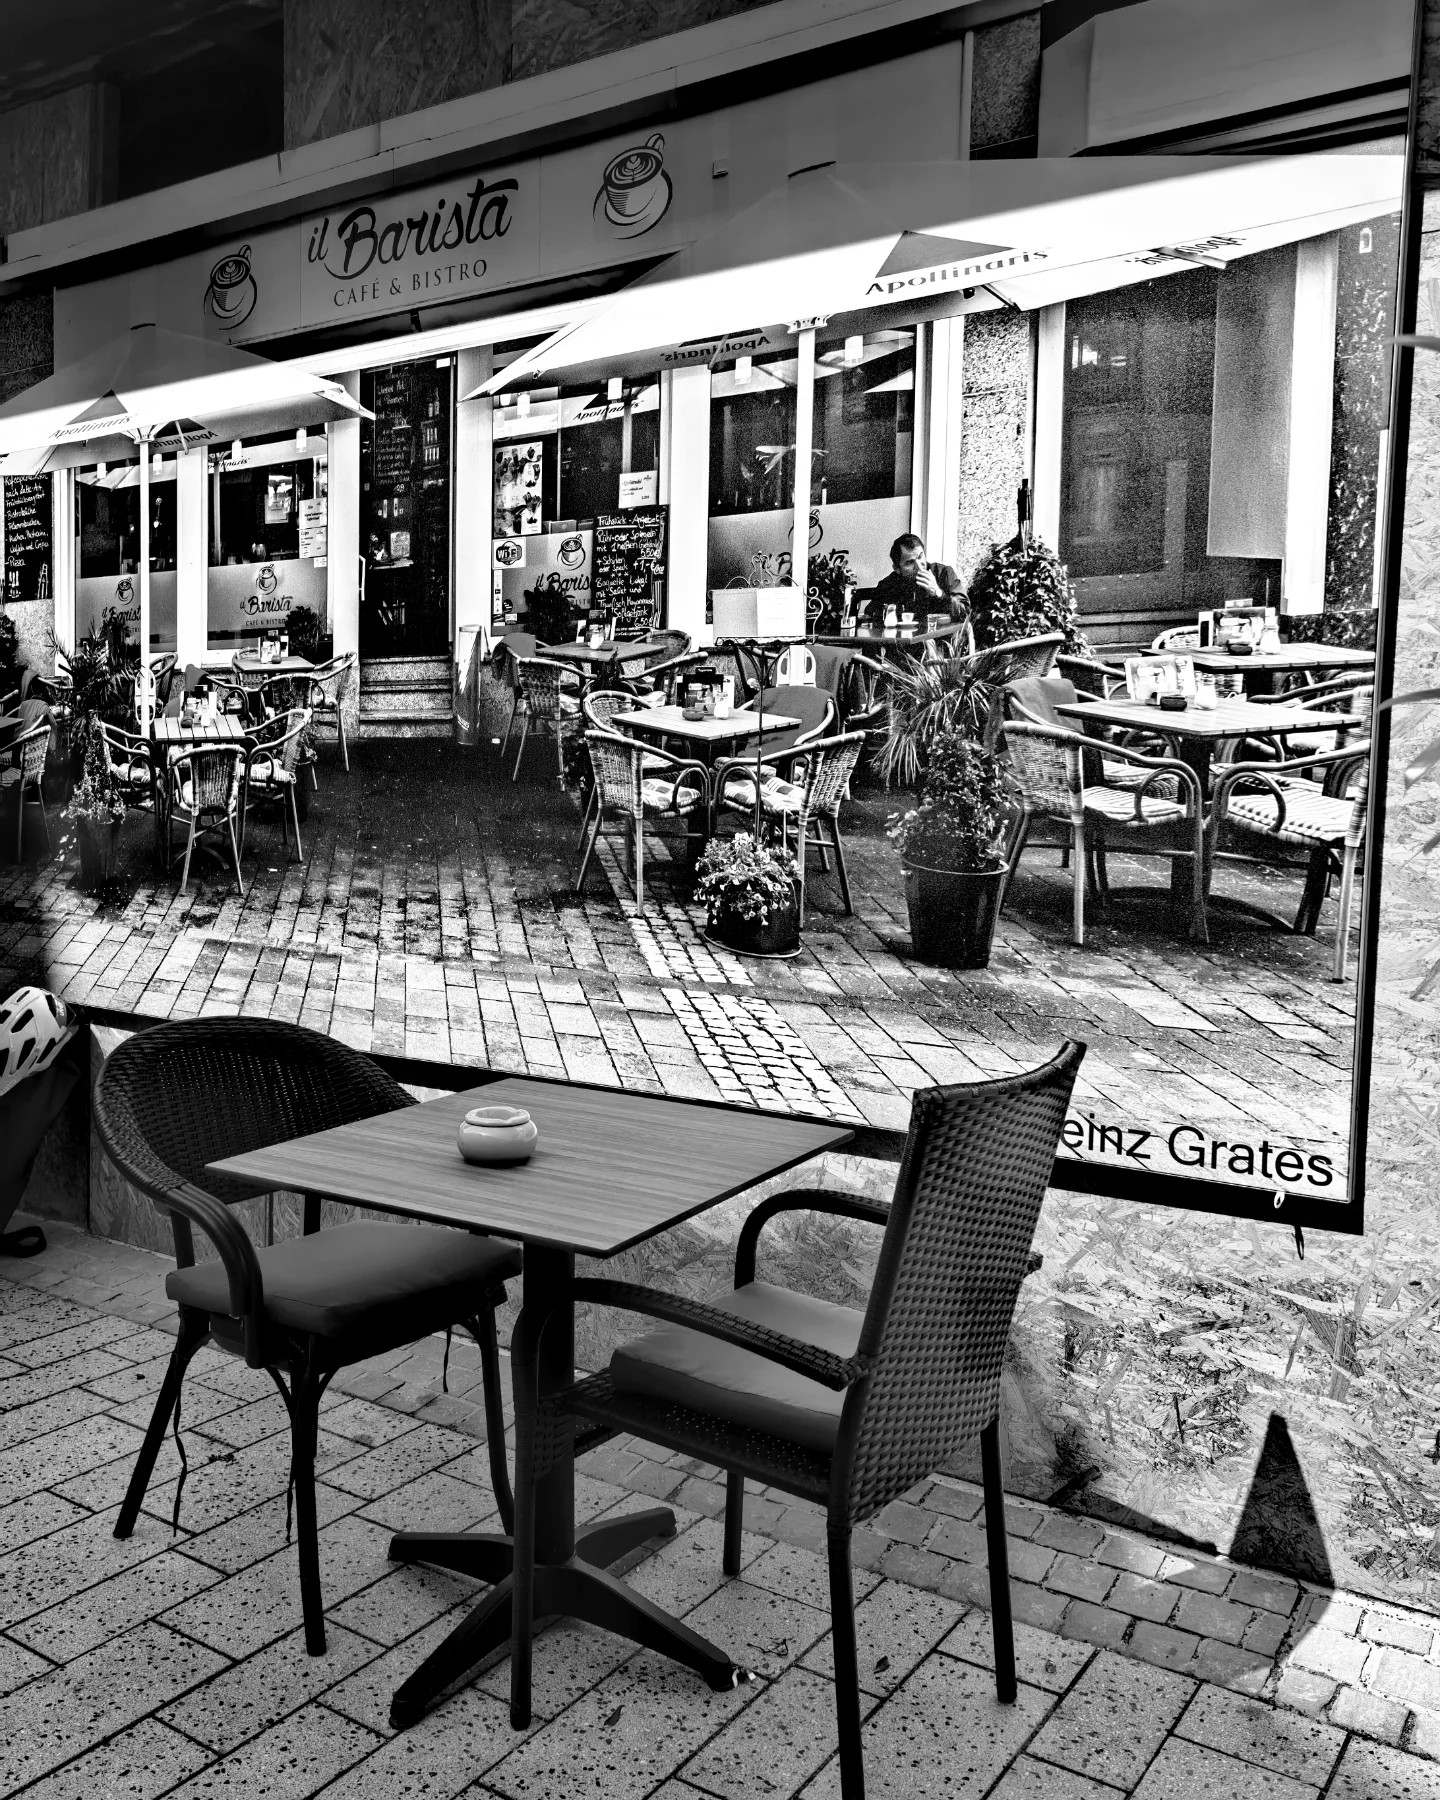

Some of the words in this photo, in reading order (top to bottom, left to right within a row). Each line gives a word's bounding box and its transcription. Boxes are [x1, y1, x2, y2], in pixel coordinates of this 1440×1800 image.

[308, 217, 329, 263] il
[324, 178, 519, 280] Barista
[333, 277, 380, 307] CAFÉ
[389, 277, 402, 296] &
[412, 259, 488, 291] BISTRO
[865, 251, 1049, 296] Apollinaris
[49, 416, 131, 439] Apollinaris
[547, 572, 591, 592] Baris
[109, 605, 142, 622] Barist
[244, 594, 293, 615] Barista
[1060, 1113, 1152, 1159] einz
[1168, 1124, 1334, 1187] Grates
